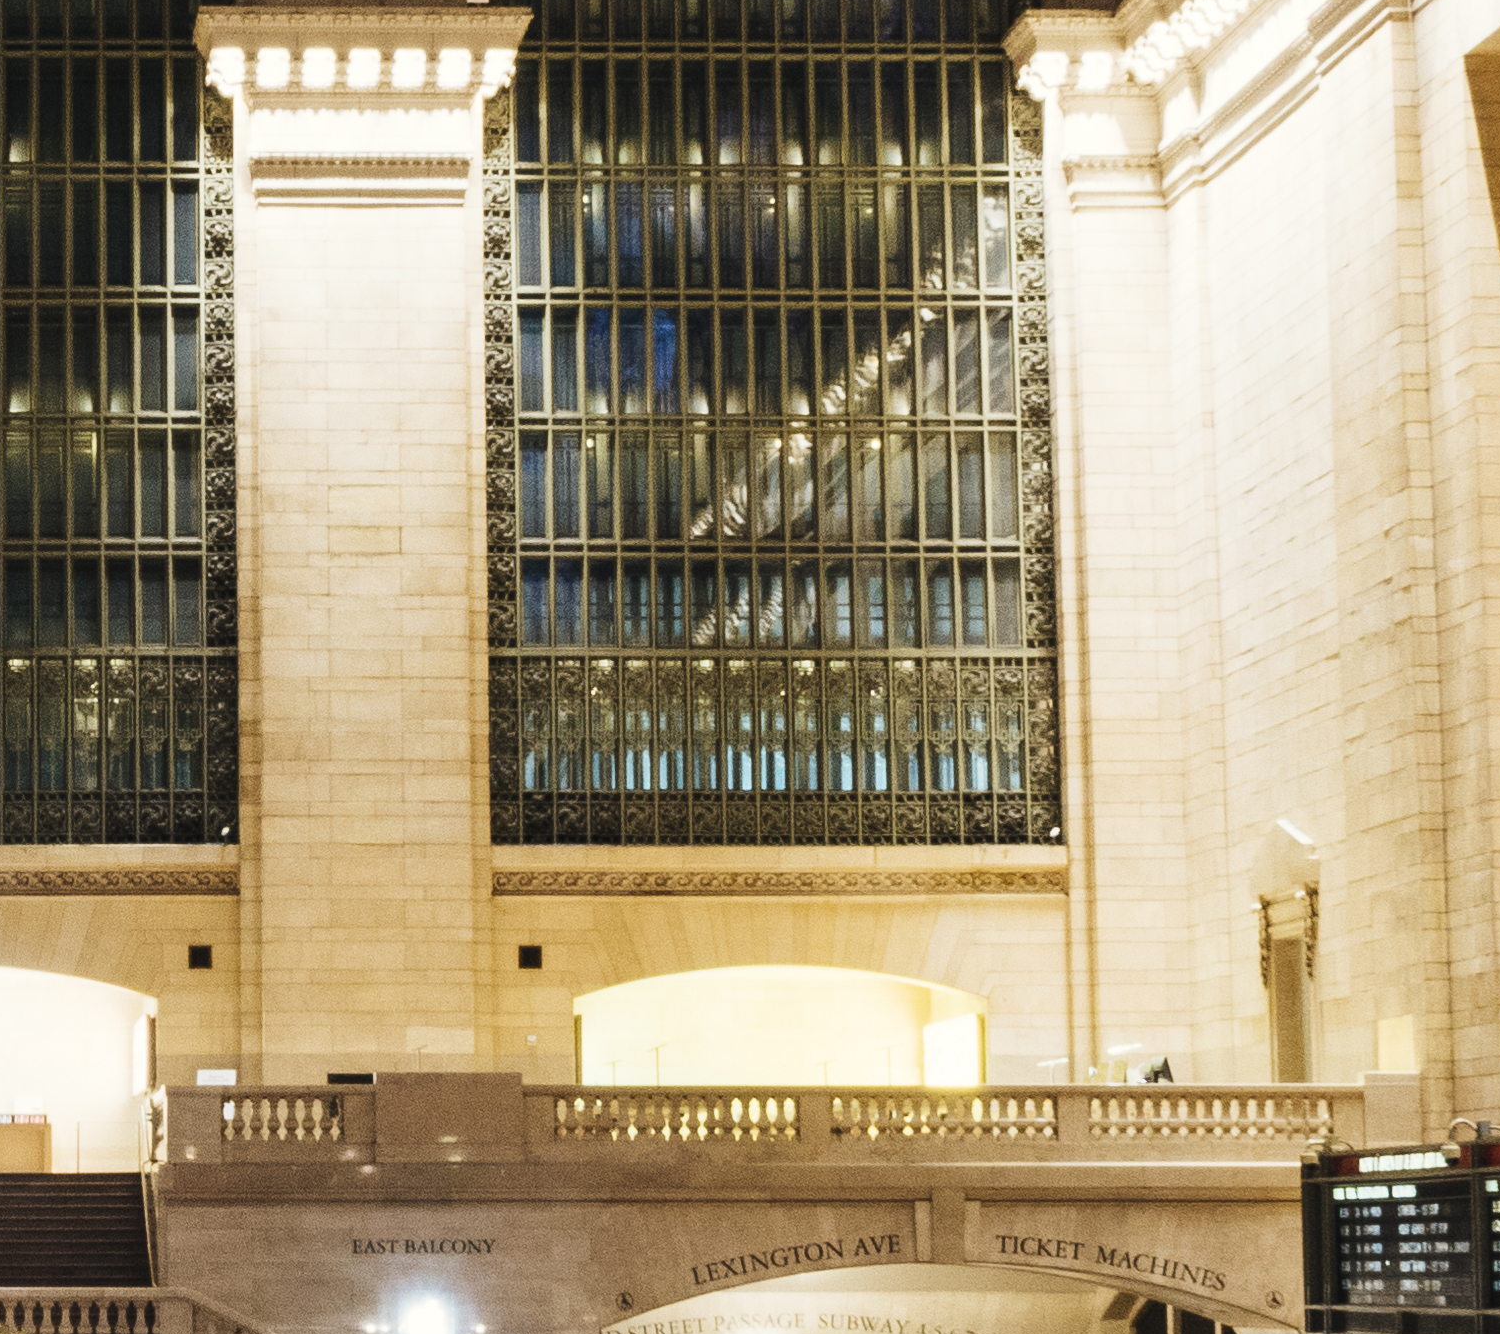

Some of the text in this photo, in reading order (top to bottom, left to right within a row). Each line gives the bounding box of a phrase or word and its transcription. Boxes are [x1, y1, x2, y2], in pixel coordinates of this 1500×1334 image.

[353, 1238, 496, 1254] EAST BALCONY
[691, 1234, 901, 1285] LEXINGTON AVE
[995, 1234, 1227, 1292] TICKET MACHINES
[713, 1312, 806, 1332] PASSAGE
